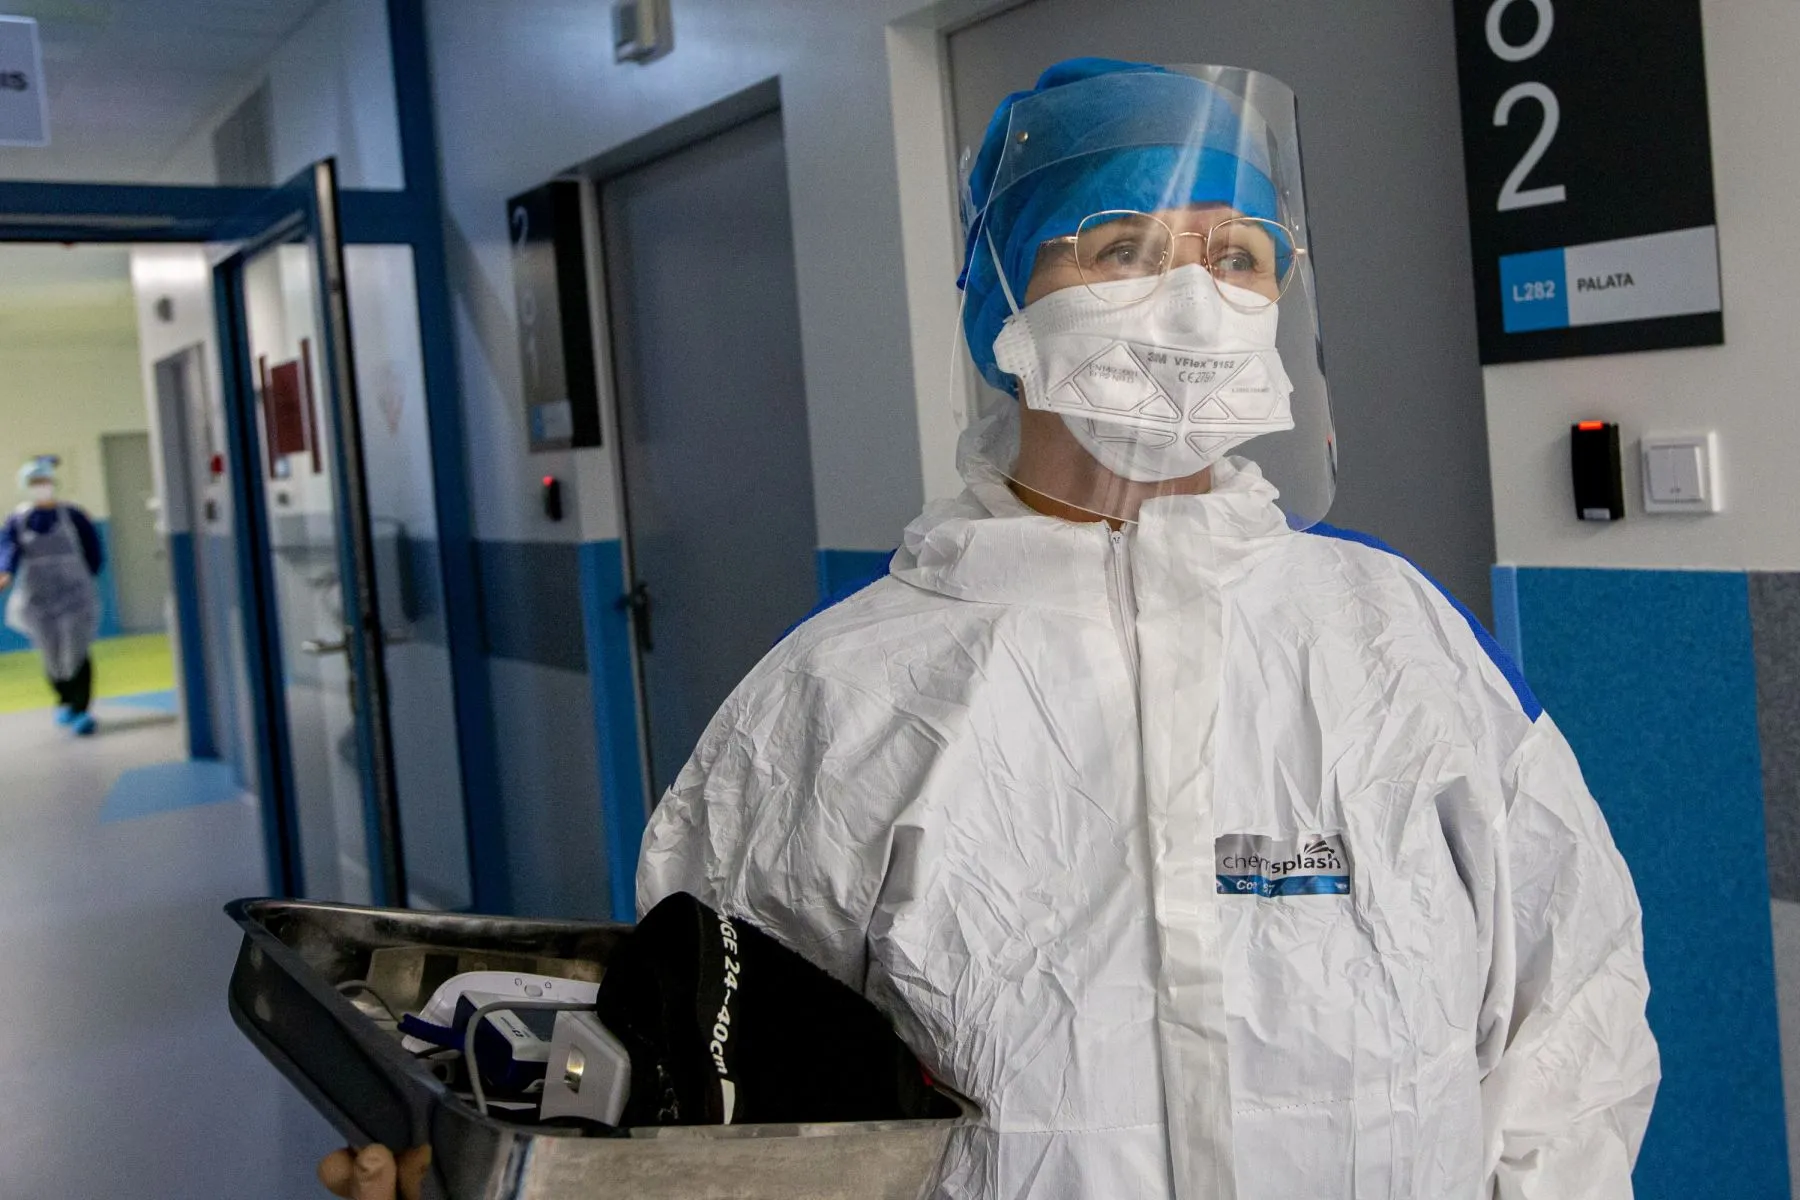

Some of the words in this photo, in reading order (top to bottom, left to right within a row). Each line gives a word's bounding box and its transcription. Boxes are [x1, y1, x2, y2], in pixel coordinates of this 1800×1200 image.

[1512, 280, 1556, 302] L282
[1576, 272, 1635, 293] PALATA
[1147, 351, 1167, 365] 3M
[1222, 854, 1342, 875] chemsplash
